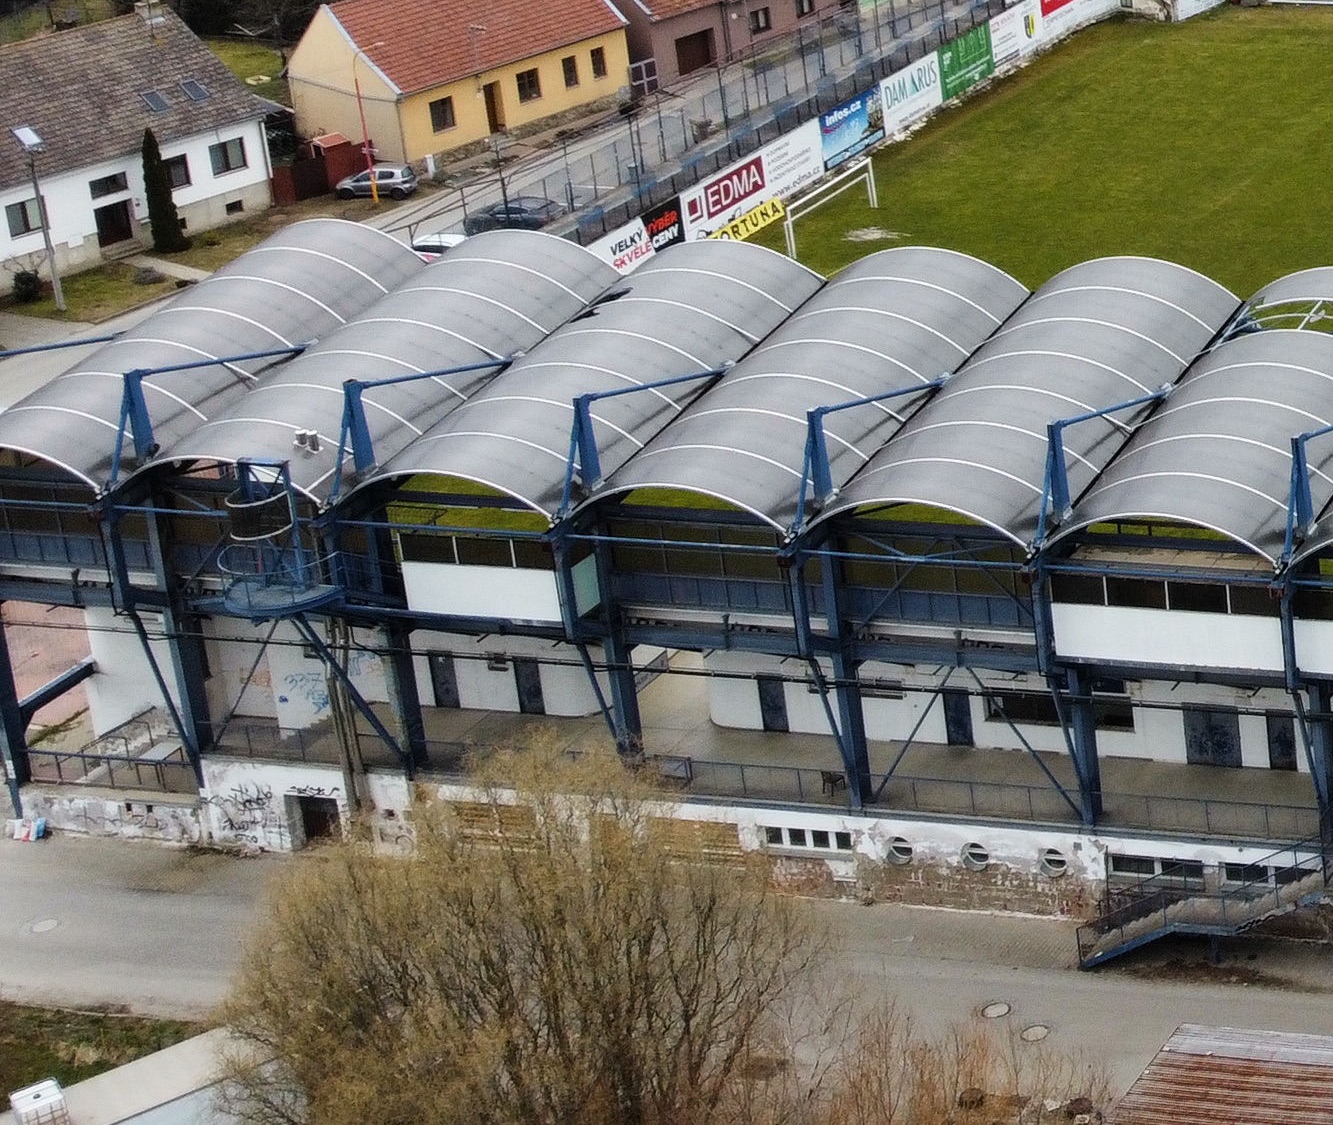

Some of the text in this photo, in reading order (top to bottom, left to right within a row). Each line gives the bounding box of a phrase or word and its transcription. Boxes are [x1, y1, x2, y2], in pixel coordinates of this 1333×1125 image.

[707, 165, 763, 213] EDMA
[610, 228, 644, 256] VELKÝ
[652, 223, 680, 248] CENY
